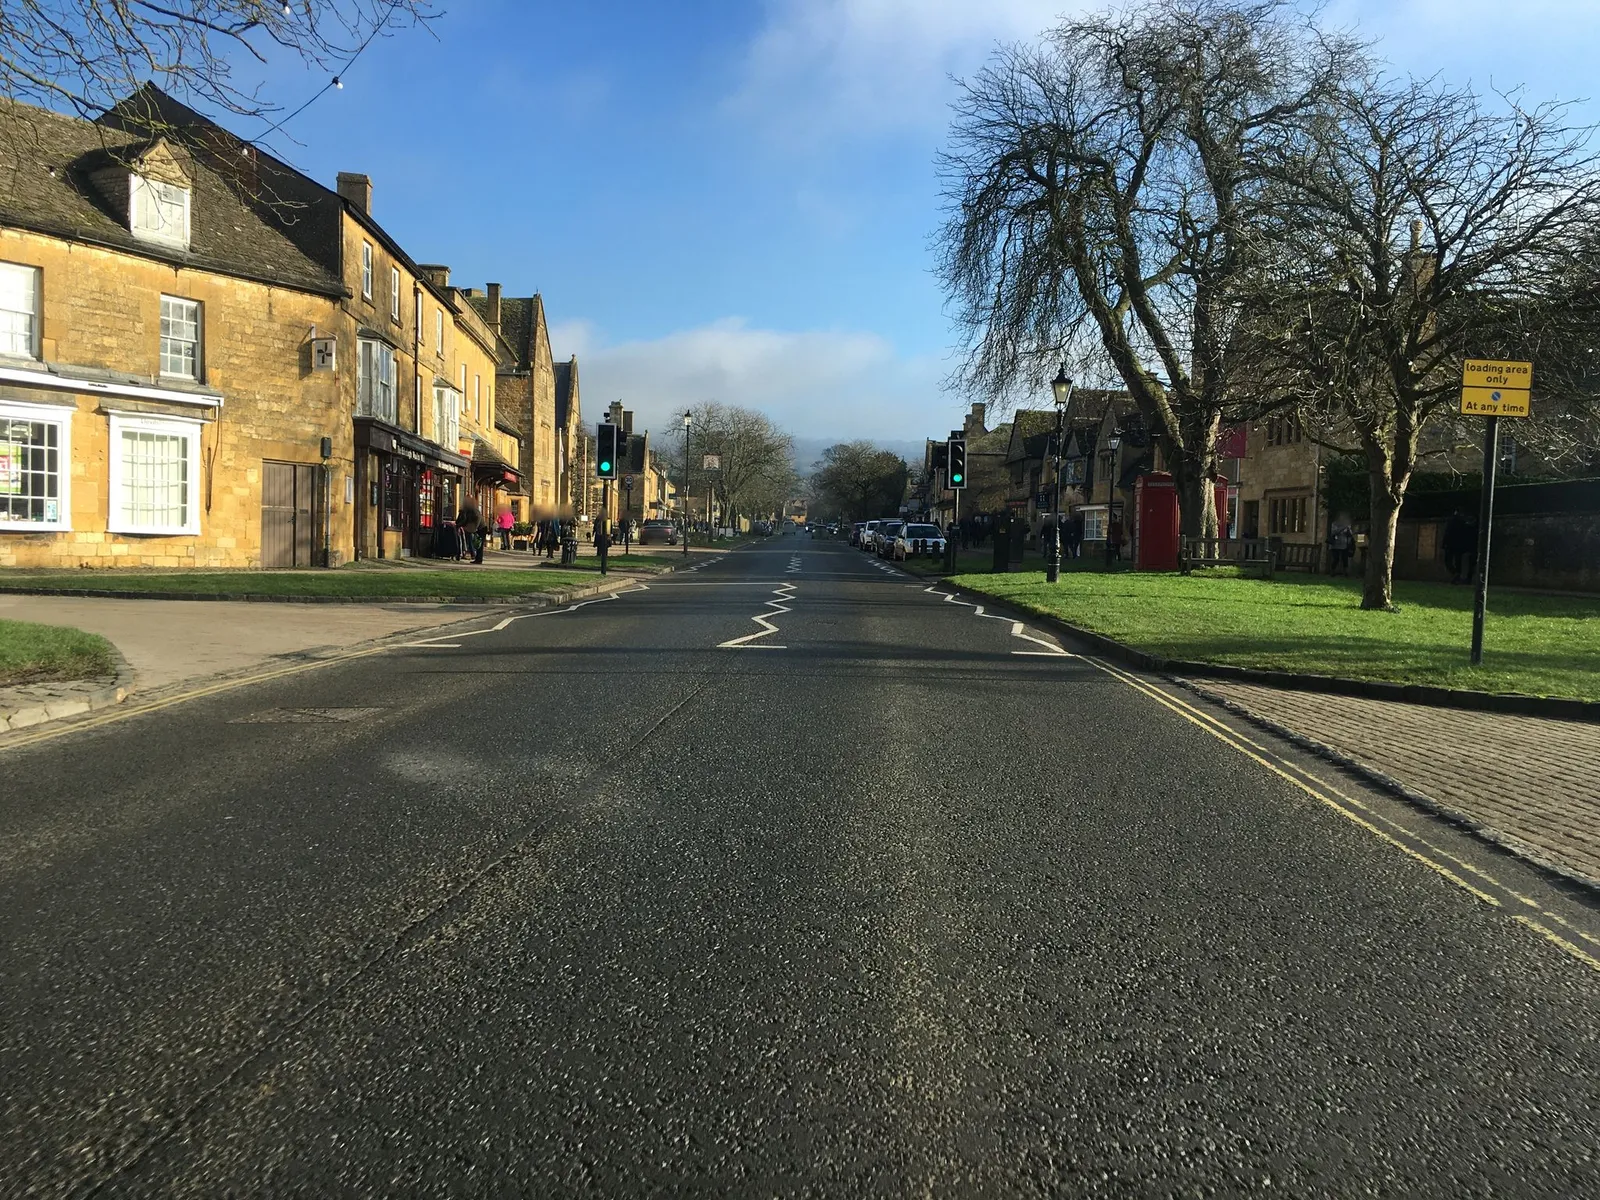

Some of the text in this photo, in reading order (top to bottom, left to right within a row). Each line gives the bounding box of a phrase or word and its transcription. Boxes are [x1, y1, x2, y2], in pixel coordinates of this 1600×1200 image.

[1466, 363, 1528, 374] loading area
[1486, 375, 1508, 384] only
[1466, 402, 1524, 412] At any time
